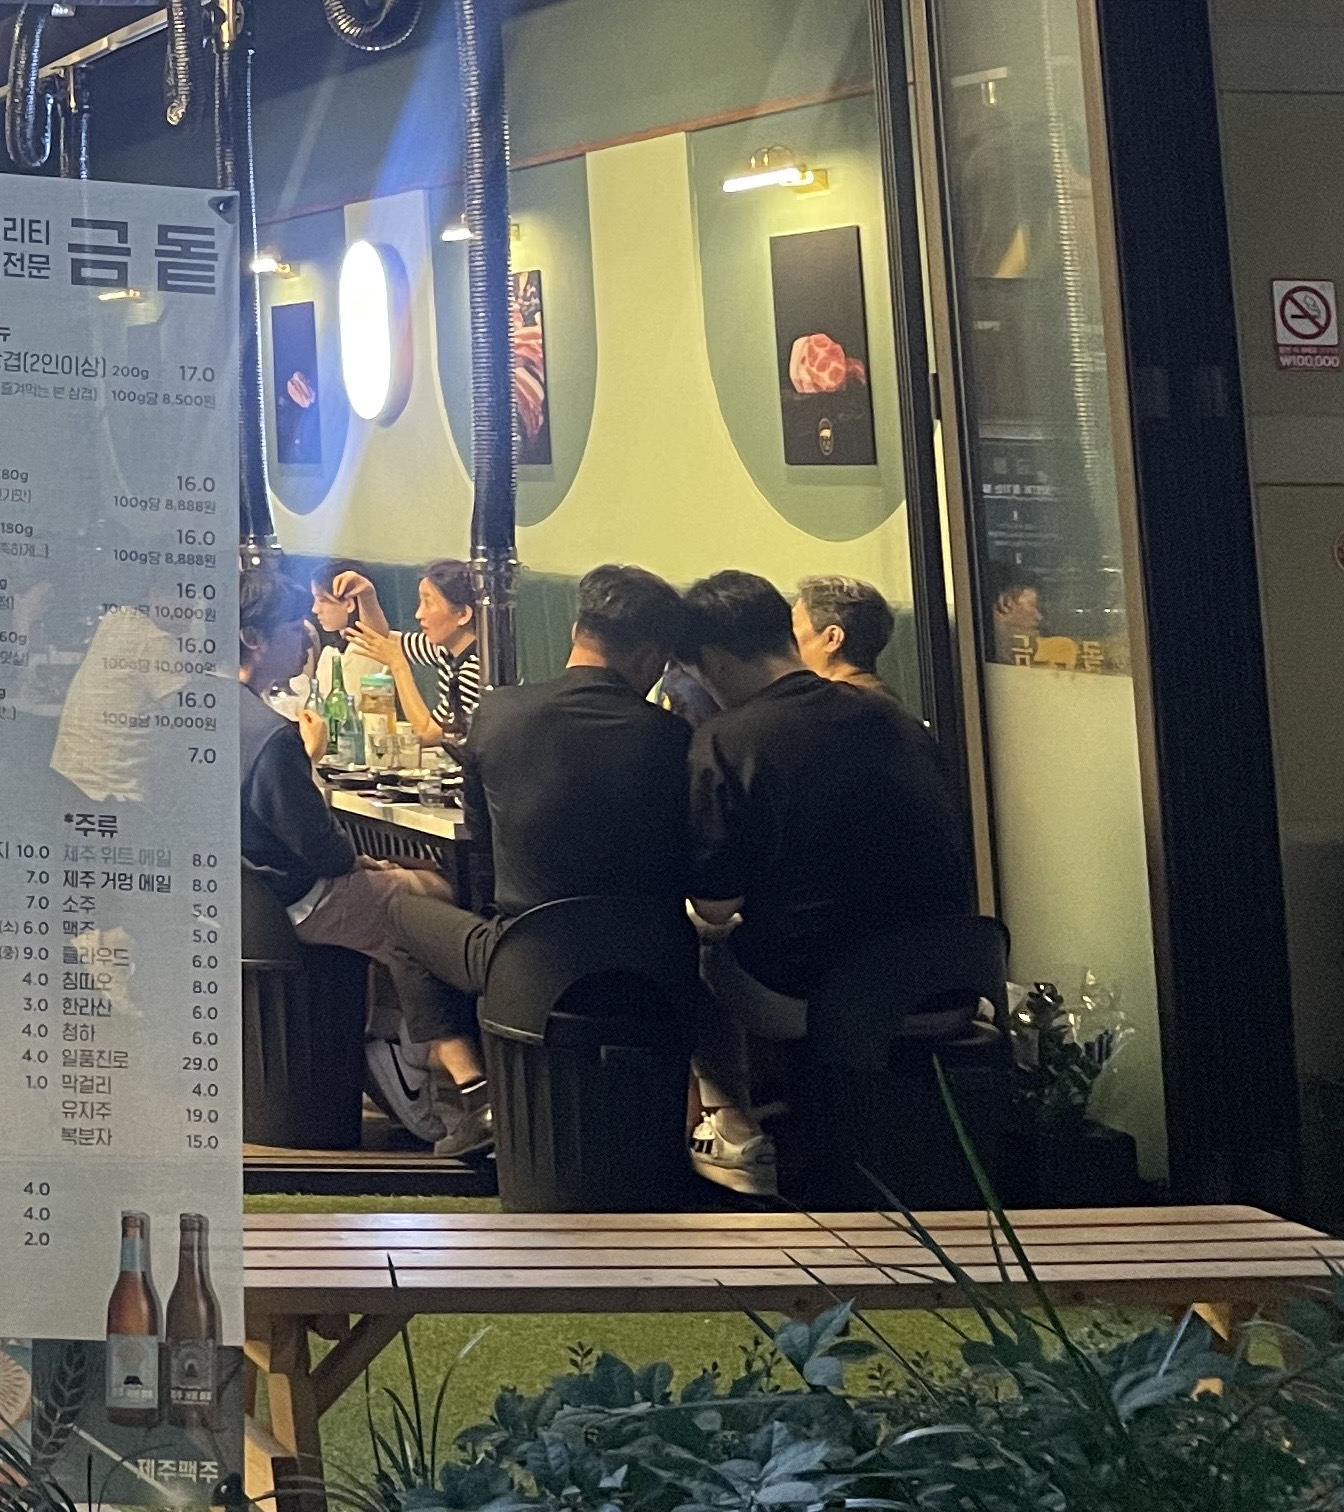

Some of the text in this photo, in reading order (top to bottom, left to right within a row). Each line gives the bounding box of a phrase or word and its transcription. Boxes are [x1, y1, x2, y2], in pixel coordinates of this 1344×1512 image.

[67, 217, 219, 296] 금 돝
[112, 365, 149, 381] 200g
[179, 365, 215, 383] 17.0
[111, 389, 159, 406] 100g당
[177, 475, 216, 492] 16.0
[113, 495, 216, 515] 100g당 8,888원
[176, 529, 216, 546] 16.0
[113, 549, 216, 568] 100g당 8,888원
[176, 582, 216, 600] 16.0
[177, 636, 216, 654] 16.0
[177, 691, 216, 709] 16.0
[187, 747, 216, 764] 7.0
[17, 844, 50, 859] 10.0
[63, 844, 218, 868] 제주 위트 에일 8.0
[26, 870, 50, 884] 7.0
[63, 869, 218, 893] 제주 거멍 에일 8.0
[26, 896, 50, 910] 7.0
[62, 895, 218, 918] 소주 5.0
[23, 921, 49, 935] 6.0
[192, 929, 218, 943] 5.0
[23, 946, 49, 961] 9.0
[62, 945, 218, 969] 클라우드 6.0
[22, 972, 49, 986] 4.0
[192, 980, 219, 994] 8.0
[23, 998, 49, 1013] 3.0
[62, 996, 218, 1020] 한라산 6.0
[21, 1024, 49, 1038] 4.0
[62, 1022, 219, 1046] 청하 6.0
[21, 1049, 49, 1064] 4.0
[62, 1048, 219, 1072] 일품진로 29.0
[25, 1075, 49, 1090] 1.0
[62, 1074, 219, 1097] 막걸리 4.0
[185, 1108, 219, 1124] 19.0
[61, 1127, 219, 1150] 복분자 15.0
[23, 1181, 51, 1196] 4.0
[23, 1207, 51, 1222] 4.0
[23, 1232, 51, 1247] 2.0
[136, 1458, 219, 1484] 제주맥주
